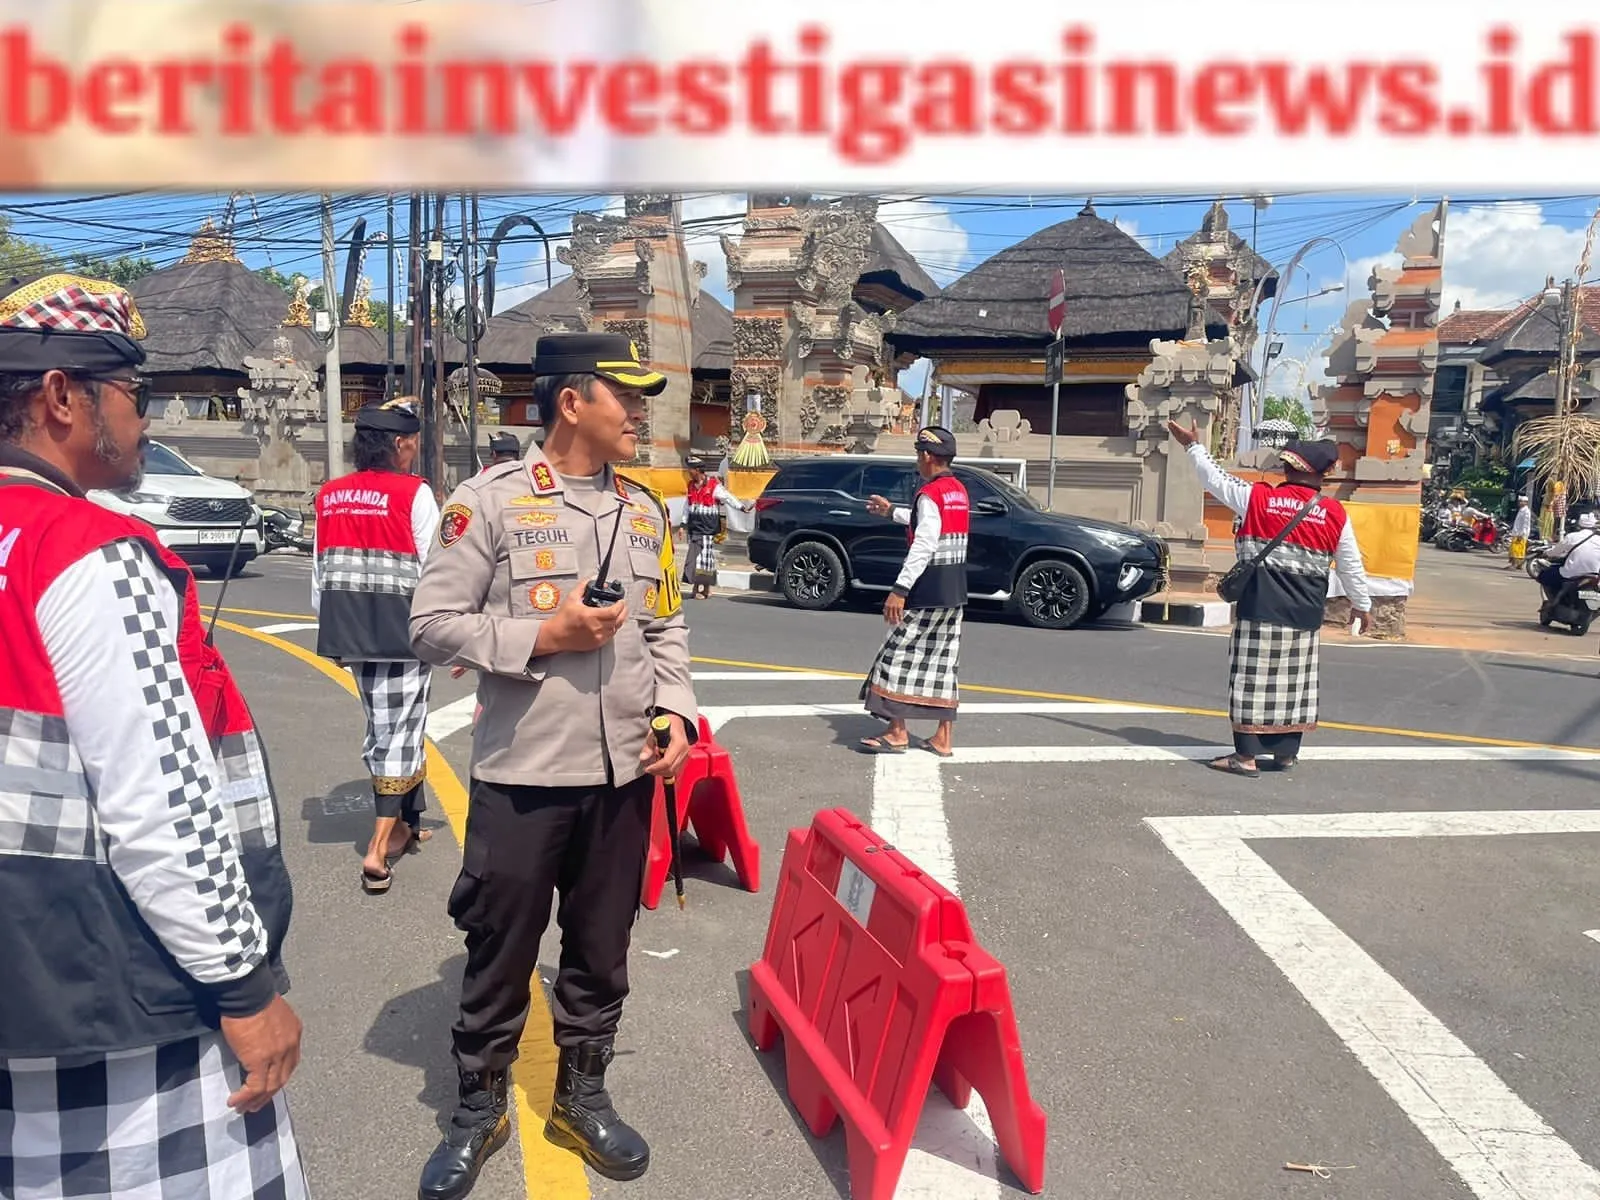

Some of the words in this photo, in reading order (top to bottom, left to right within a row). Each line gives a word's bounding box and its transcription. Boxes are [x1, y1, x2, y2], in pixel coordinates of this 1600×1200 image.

[323, 489, 389, 508] BANKAMDA
[1268, 497, 1327, 519] BANKADA
[513, 529, 568, 547] TEGUH
[630, 535, 660, 555] POLRI
